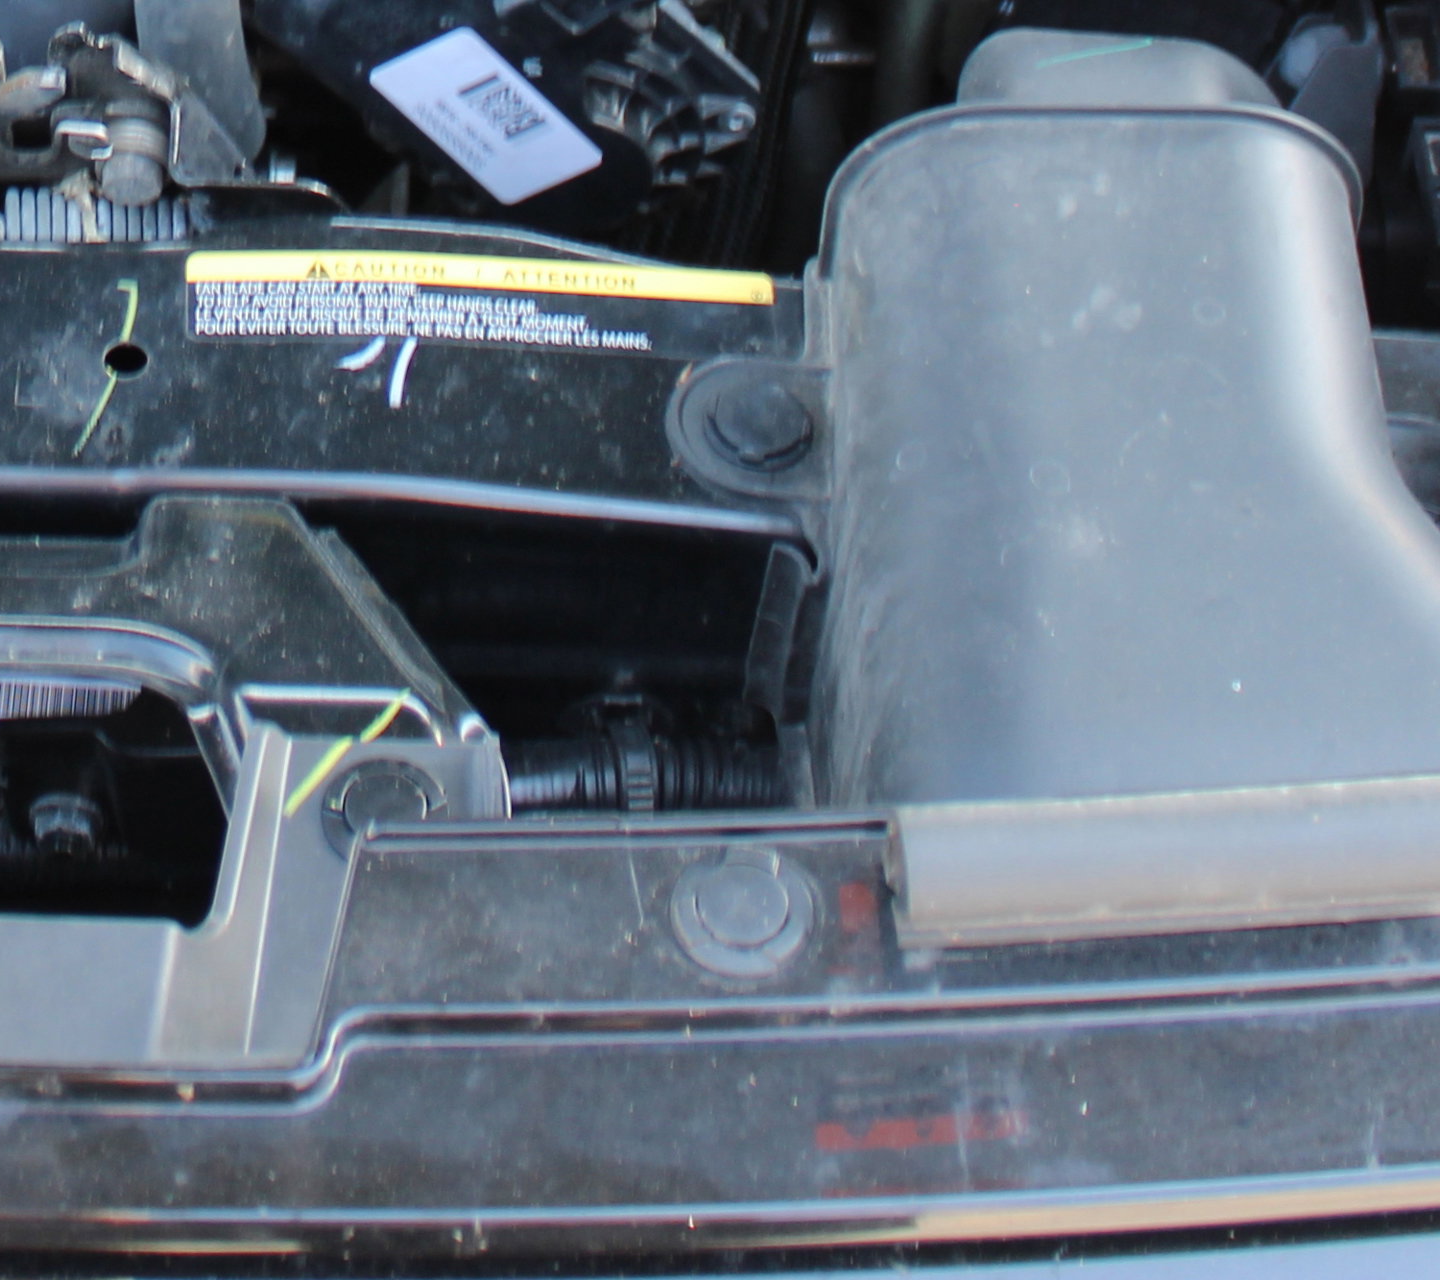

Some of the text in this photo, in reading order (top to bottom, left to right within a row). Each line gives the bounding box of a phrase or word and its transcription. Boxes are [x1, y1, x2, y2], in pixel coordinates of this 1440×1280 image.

[334, 261, 446, 280] CAUTION
[503, 269, 636, 292] ATTENTION
[195, 281, 220, 295] FAN
[223, 281, 265, 295] BLADE
[269, 281, 294, 295] CAN
[297, 281, 337, 295] START
[340, 282, 355, 296] AT
[358, 282, 385, 296] ANY
[196, 295, 217, 309] TO
[221, 295, 250, 309] HELP
[252, 295, 293, 309] AVOID
[295, 294, 362, 309] PERSONAL
[414, 294, 445, 310] KEEP
[447, 295, 494, 312] HANDS
[196, 308, 211, 322] LE
[214, 307, 310, 322] VENTILATEUR
[311, 307, 369, 322] RISQUE
[373, 308, 389, 322] DE
[482, 312, 518, 328] TOUT
[195, 320, 236, 335] POUR
[290, 320, 335, 335] TOUTE
[416, 323, 433, 337] NE
[436, 323, 463, 338] PAS
[465, 325, 485, 340] EN
[487, 327, 575, 346] APPROCHER
[575, 331, 600, 348] LES
